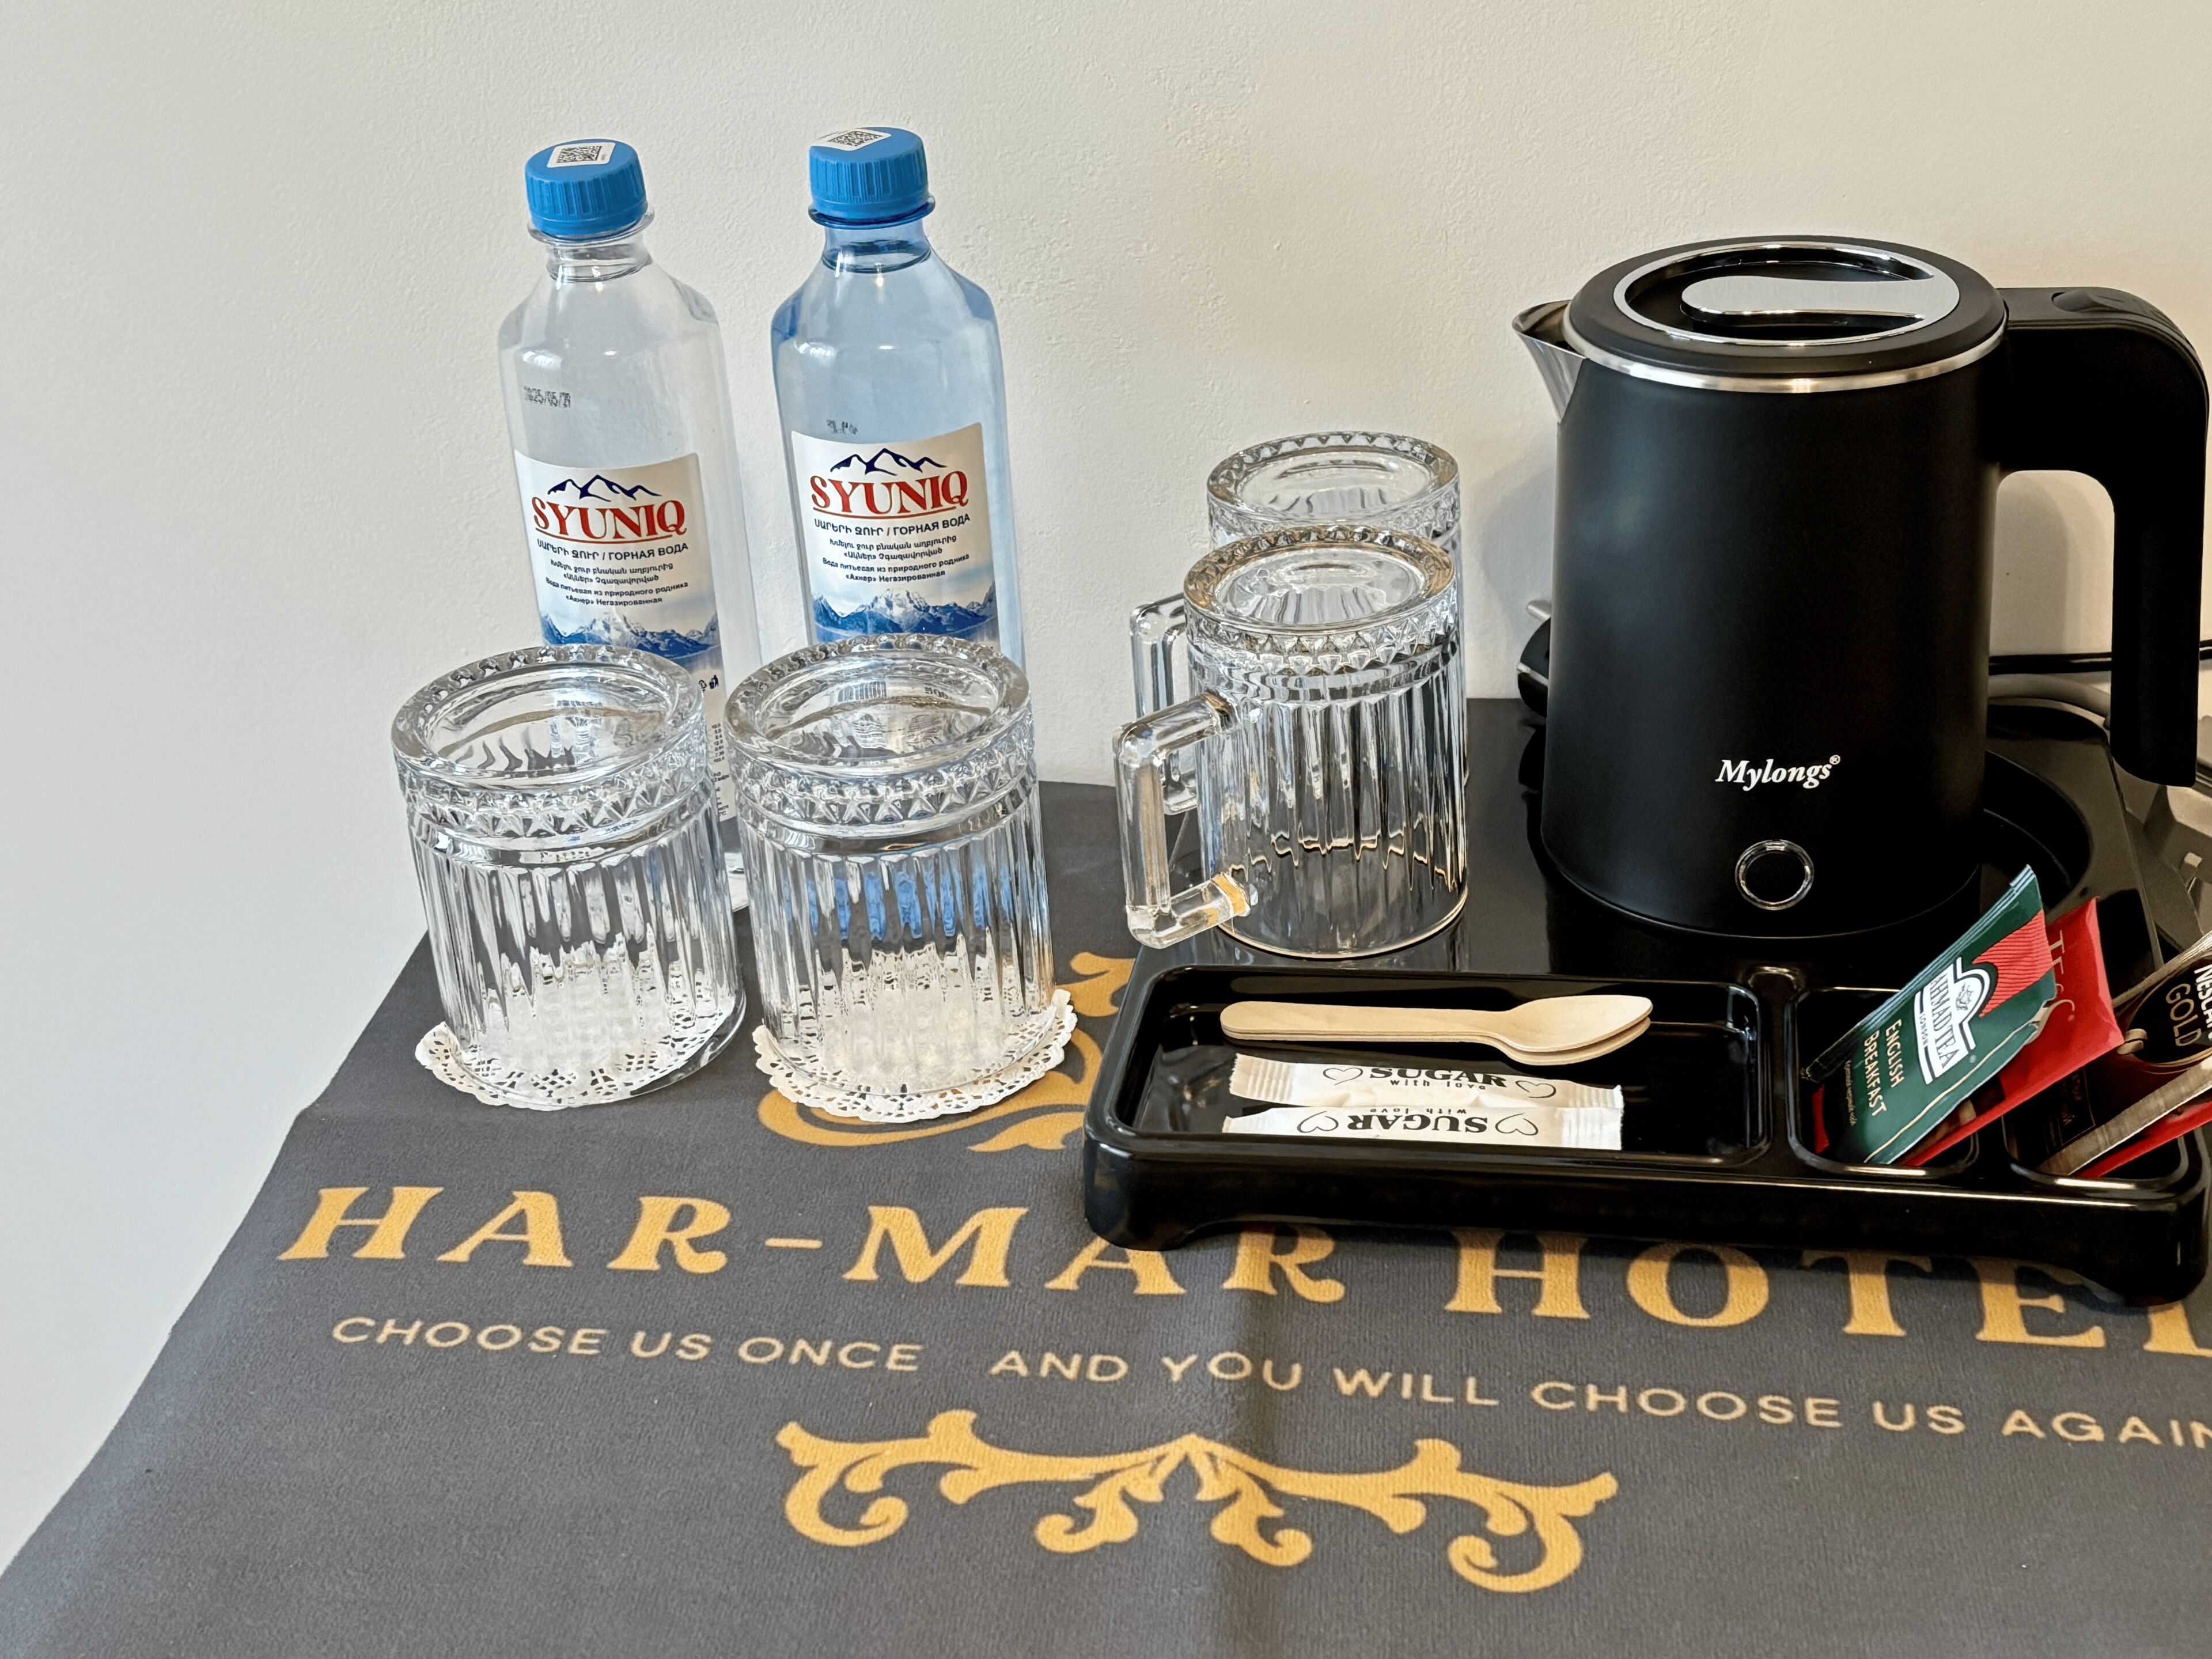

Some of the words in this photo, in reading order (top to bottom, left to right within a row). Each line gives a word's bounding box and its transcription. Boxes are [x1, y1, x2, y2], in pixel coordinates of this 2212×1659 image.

[810, 471, 969, 515] SYUNIQ
[532, 497, 687, 539] SYUNIQ
[815, 518, 852, 533] ՍԱՐԵՐԻ
[855, 527, 884, 536] ՋՈՒՐ
[893, 521, 940, 536] ГОРНАЯ
[942, 513, 971, 529] ВОДА
[608, 549, 655, 561] ГОРНАЯ
[658, 542, 689, 556] ВОДА
[1930, 973, 1953, 1032] AHMAD
[2165, 983, 2202, 1047] GOLD
[1885, 1019, 1905, 1088] ENGLISH
[1935, 1024, 1960, 1069] TEA
[1370, 1067, 1508, 1088] SUGAR
[1390, 1079, 1430, 1087] with
[1446, 1081, 1486, 1090] love
[1864, 1030, 1887, 1116] BREAKFAST
[1347, 1113, 1488, 1133] SUGAR
[331, 1316, 612, 1355] CHOOSE
[630, 1331, 712, 1361] US
[737, 1338, 923, 1372] ONCE
[988, 1349, 1129, 1382] AND
[1161, 1351, 1302, 1391] YOU
[1332, 1366, 1499, 1407] WILL
[1530, 1381, 1843, 1429] CHOOSE
[1872, 1400, 1965, 1435] US
